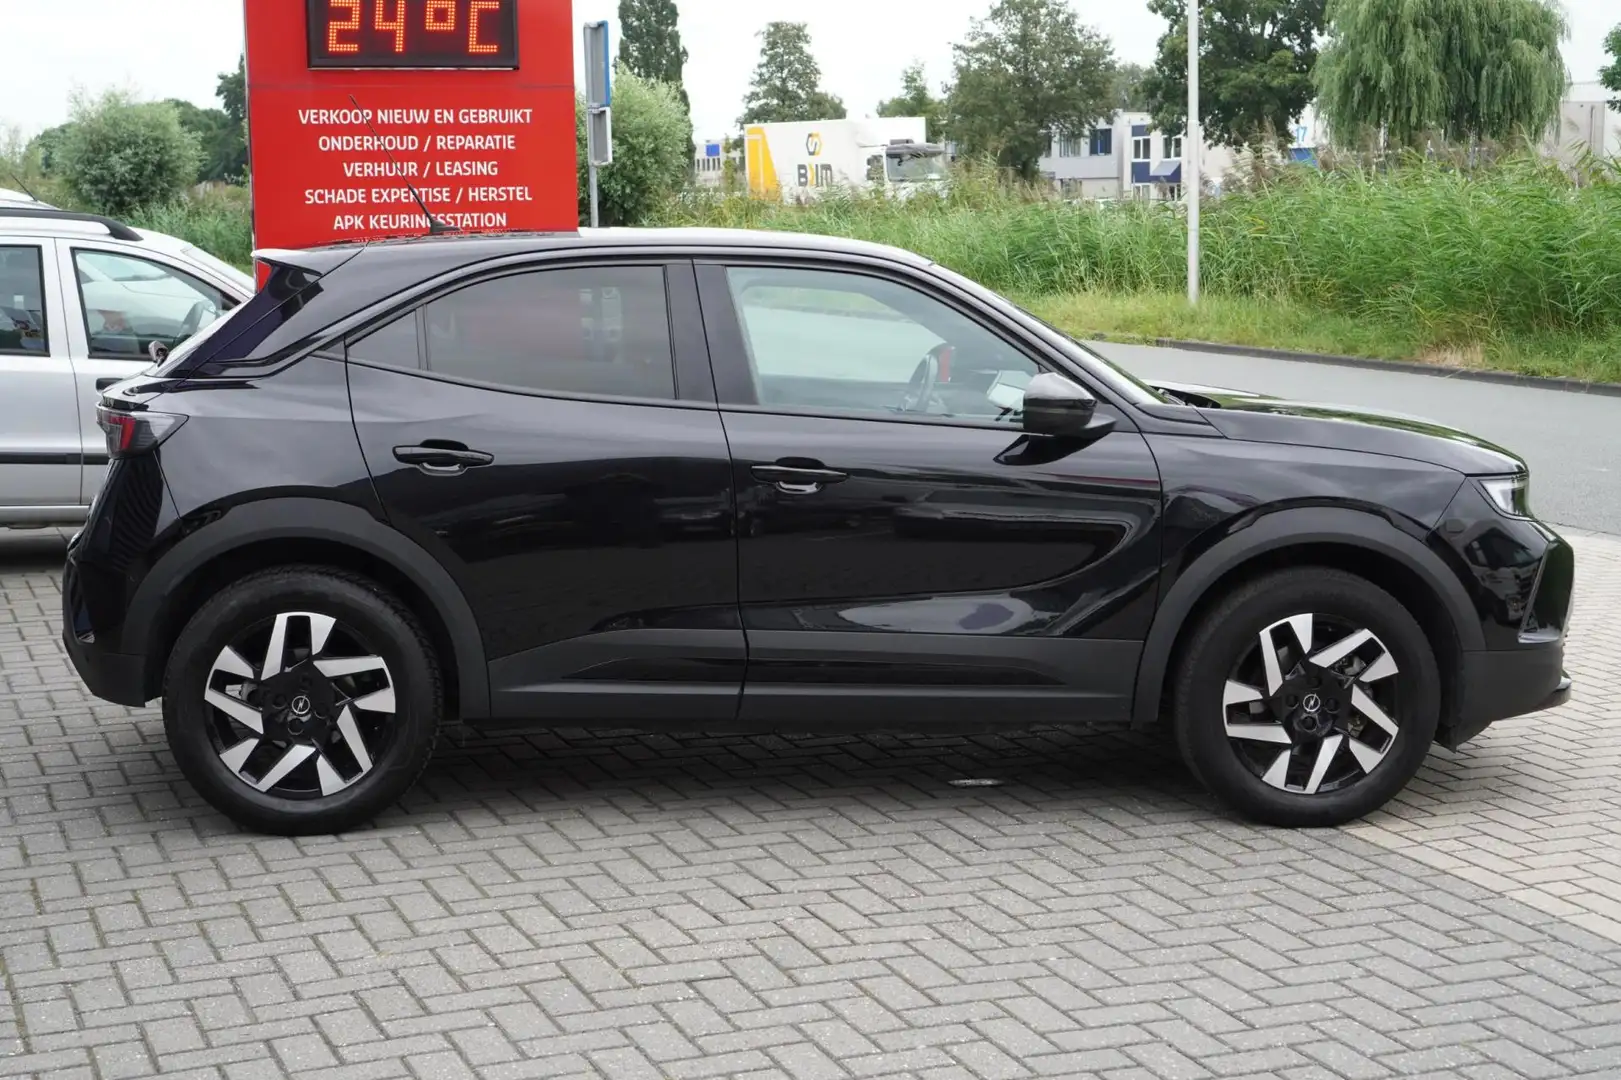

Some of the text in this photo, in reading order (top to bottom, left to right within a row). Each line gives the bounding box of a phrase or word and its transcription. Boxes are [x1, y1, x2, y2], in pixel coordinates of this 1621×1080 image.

[298, 109, 533, 125] VERKOOP NIEUW EN GEBRUIKT
[318, 136, 419, 152] ONDERHOUD
[436, 135, 516, 150] REPARATIE
[342, 161, 418, 178] VERHUUR
[435, 160, 498, 176] LEASING
[304, 188, 367, 204] SCHADE
[371, 187, 451, 204] EXPERTISE
[468, 186, 533, 202] HERSTEL
[333, 215, 365, 230] APK
